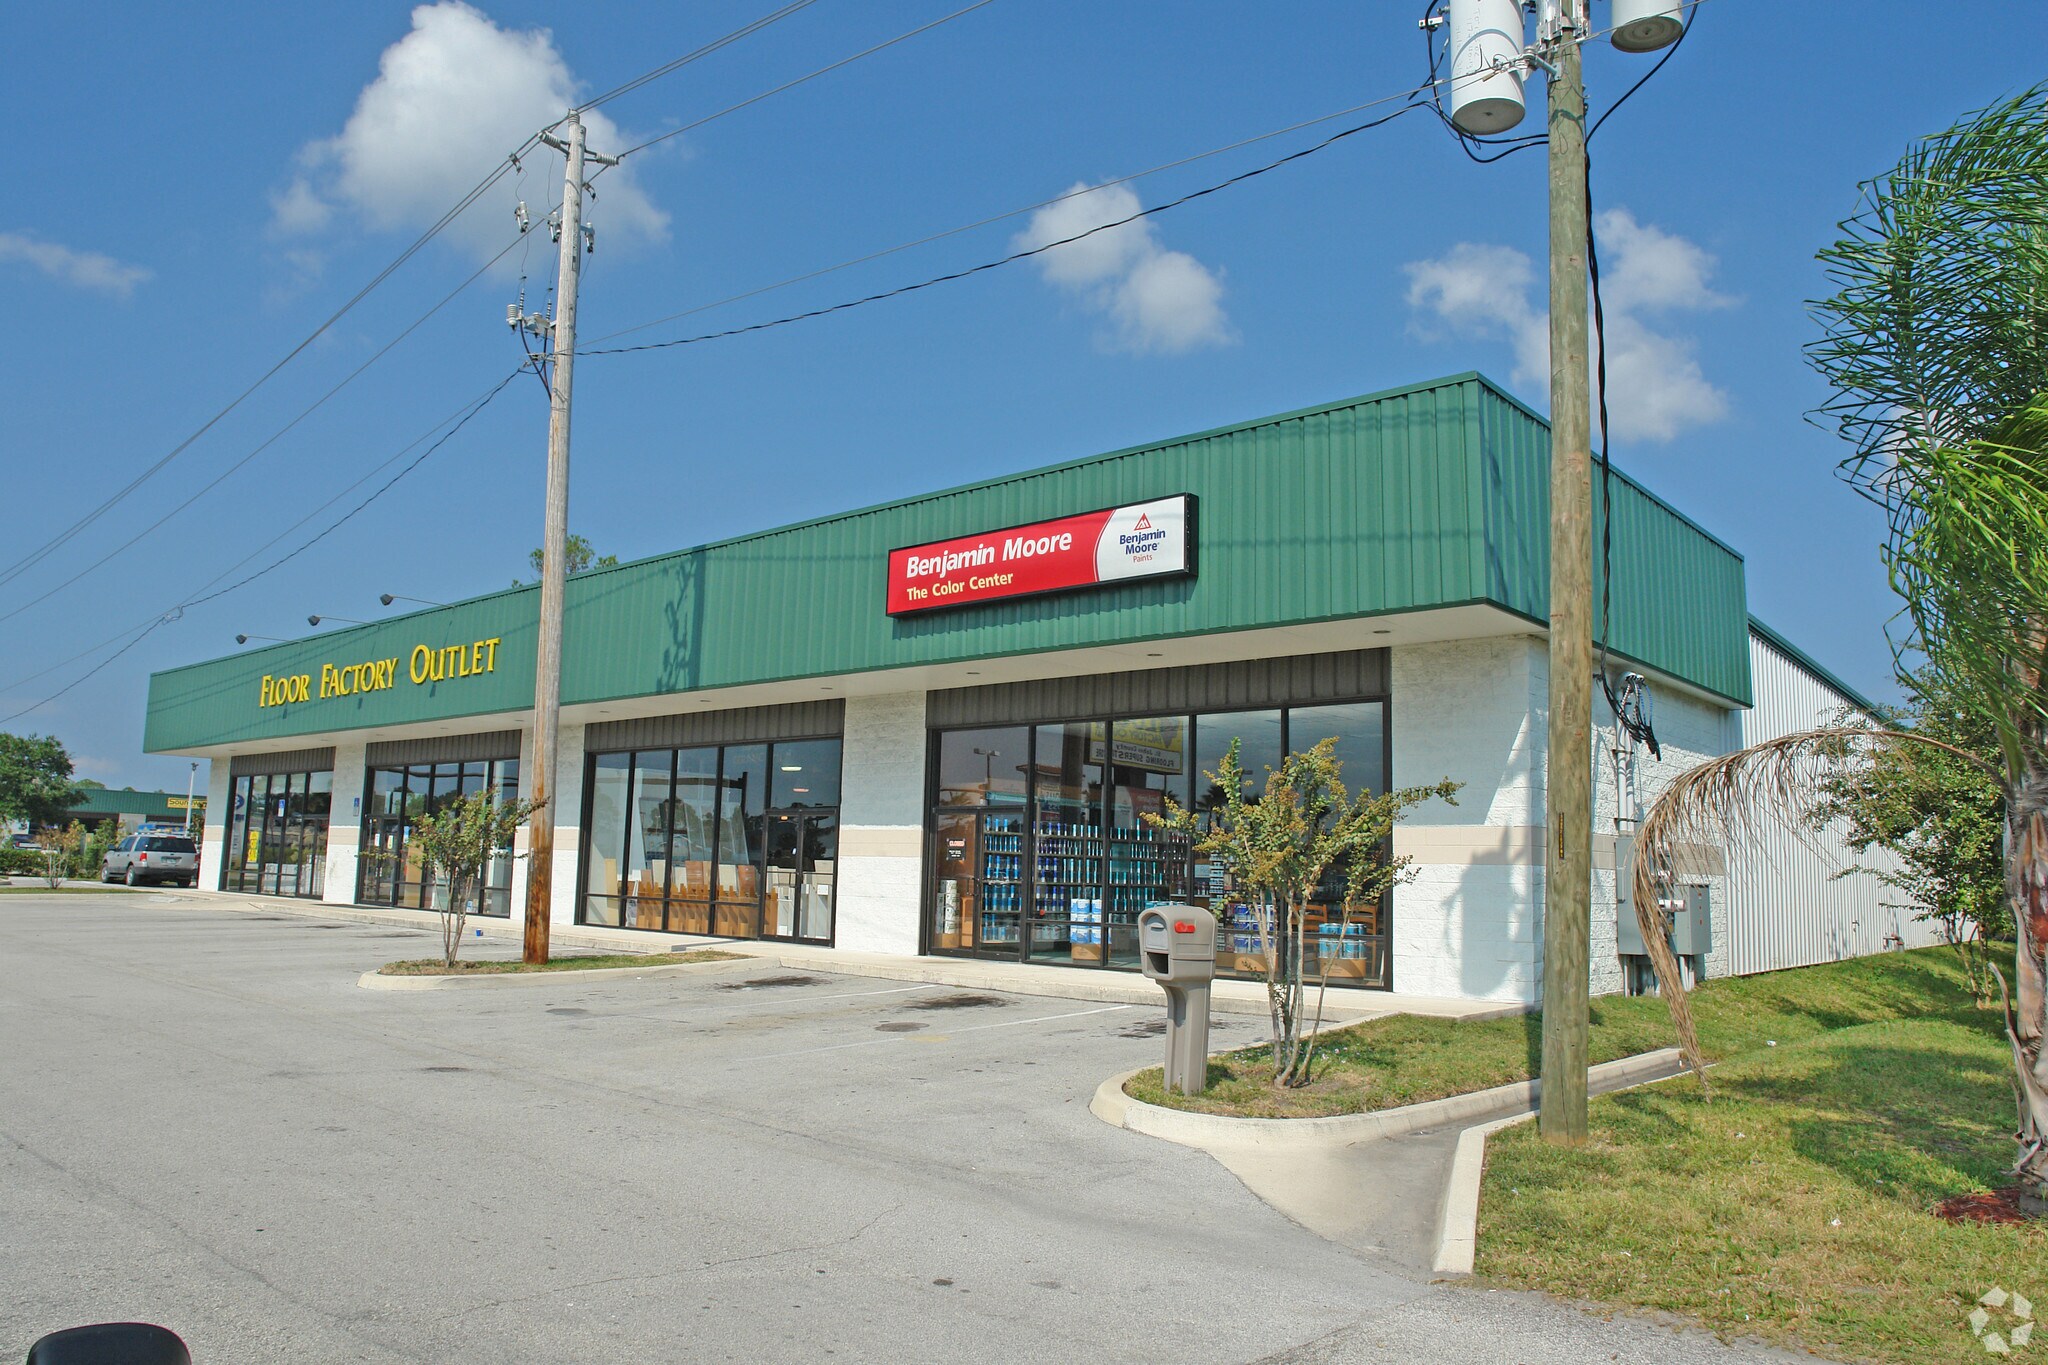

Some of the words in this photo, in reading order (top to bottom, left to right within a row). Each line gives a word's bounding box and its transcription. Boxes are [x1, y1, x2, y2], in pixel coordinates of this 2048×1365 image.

[1119, 529, 1166, 545] Benjamin
[1125, 542, 1158, 555] Moore
[906, 543, 995, 578] Benjamin
[1002, 532, 1072, 562] Moore
[1132, 554, 1153, 564] Paints
[907, 586, 928, 601] The
[932, 581, 965, 597] Color
[969, 571, 1014, 590] Center
[259, 674, 310, 708] FLOOR
[319, 657, 399, 698] FACTORY
[410, 638, 501, 685] OUTLET
